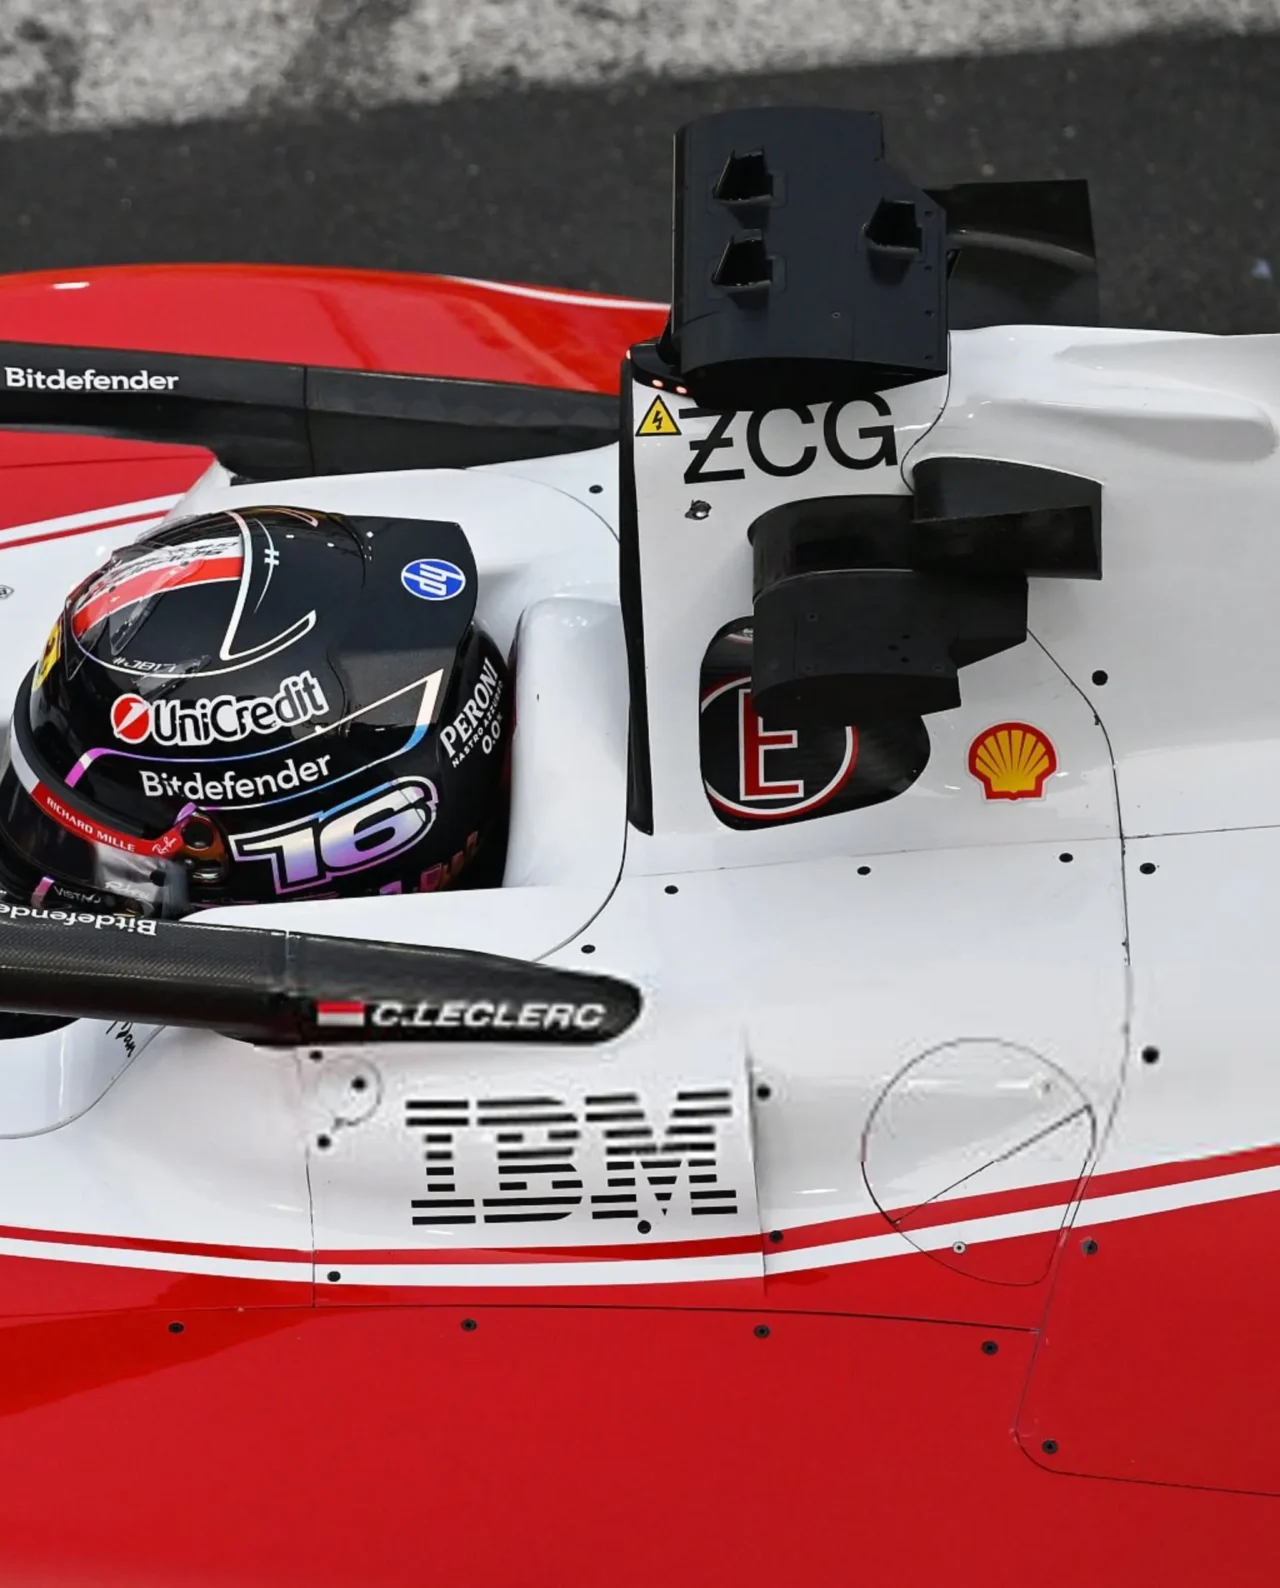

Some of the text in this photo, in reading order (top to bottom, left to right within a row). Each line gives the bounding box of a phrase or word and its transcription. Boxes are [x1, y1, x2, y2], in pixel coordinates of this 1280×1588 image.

[4, 367, 179, 392] Bitdefender
[152, 670, 329, 746] UniCredit
[439, 656, 498, 758] PERONI
[452, 726, 484, 768] NASTRO
[139, 755, 330, 800] Bitdefender
[47, 797, 135, 852] RICHARD MILLE
[231, 777, 438, 893] 16
[370, 1001, 606, 1028] C.LECLERC
[405, 1089, 738, 1226] IBM
